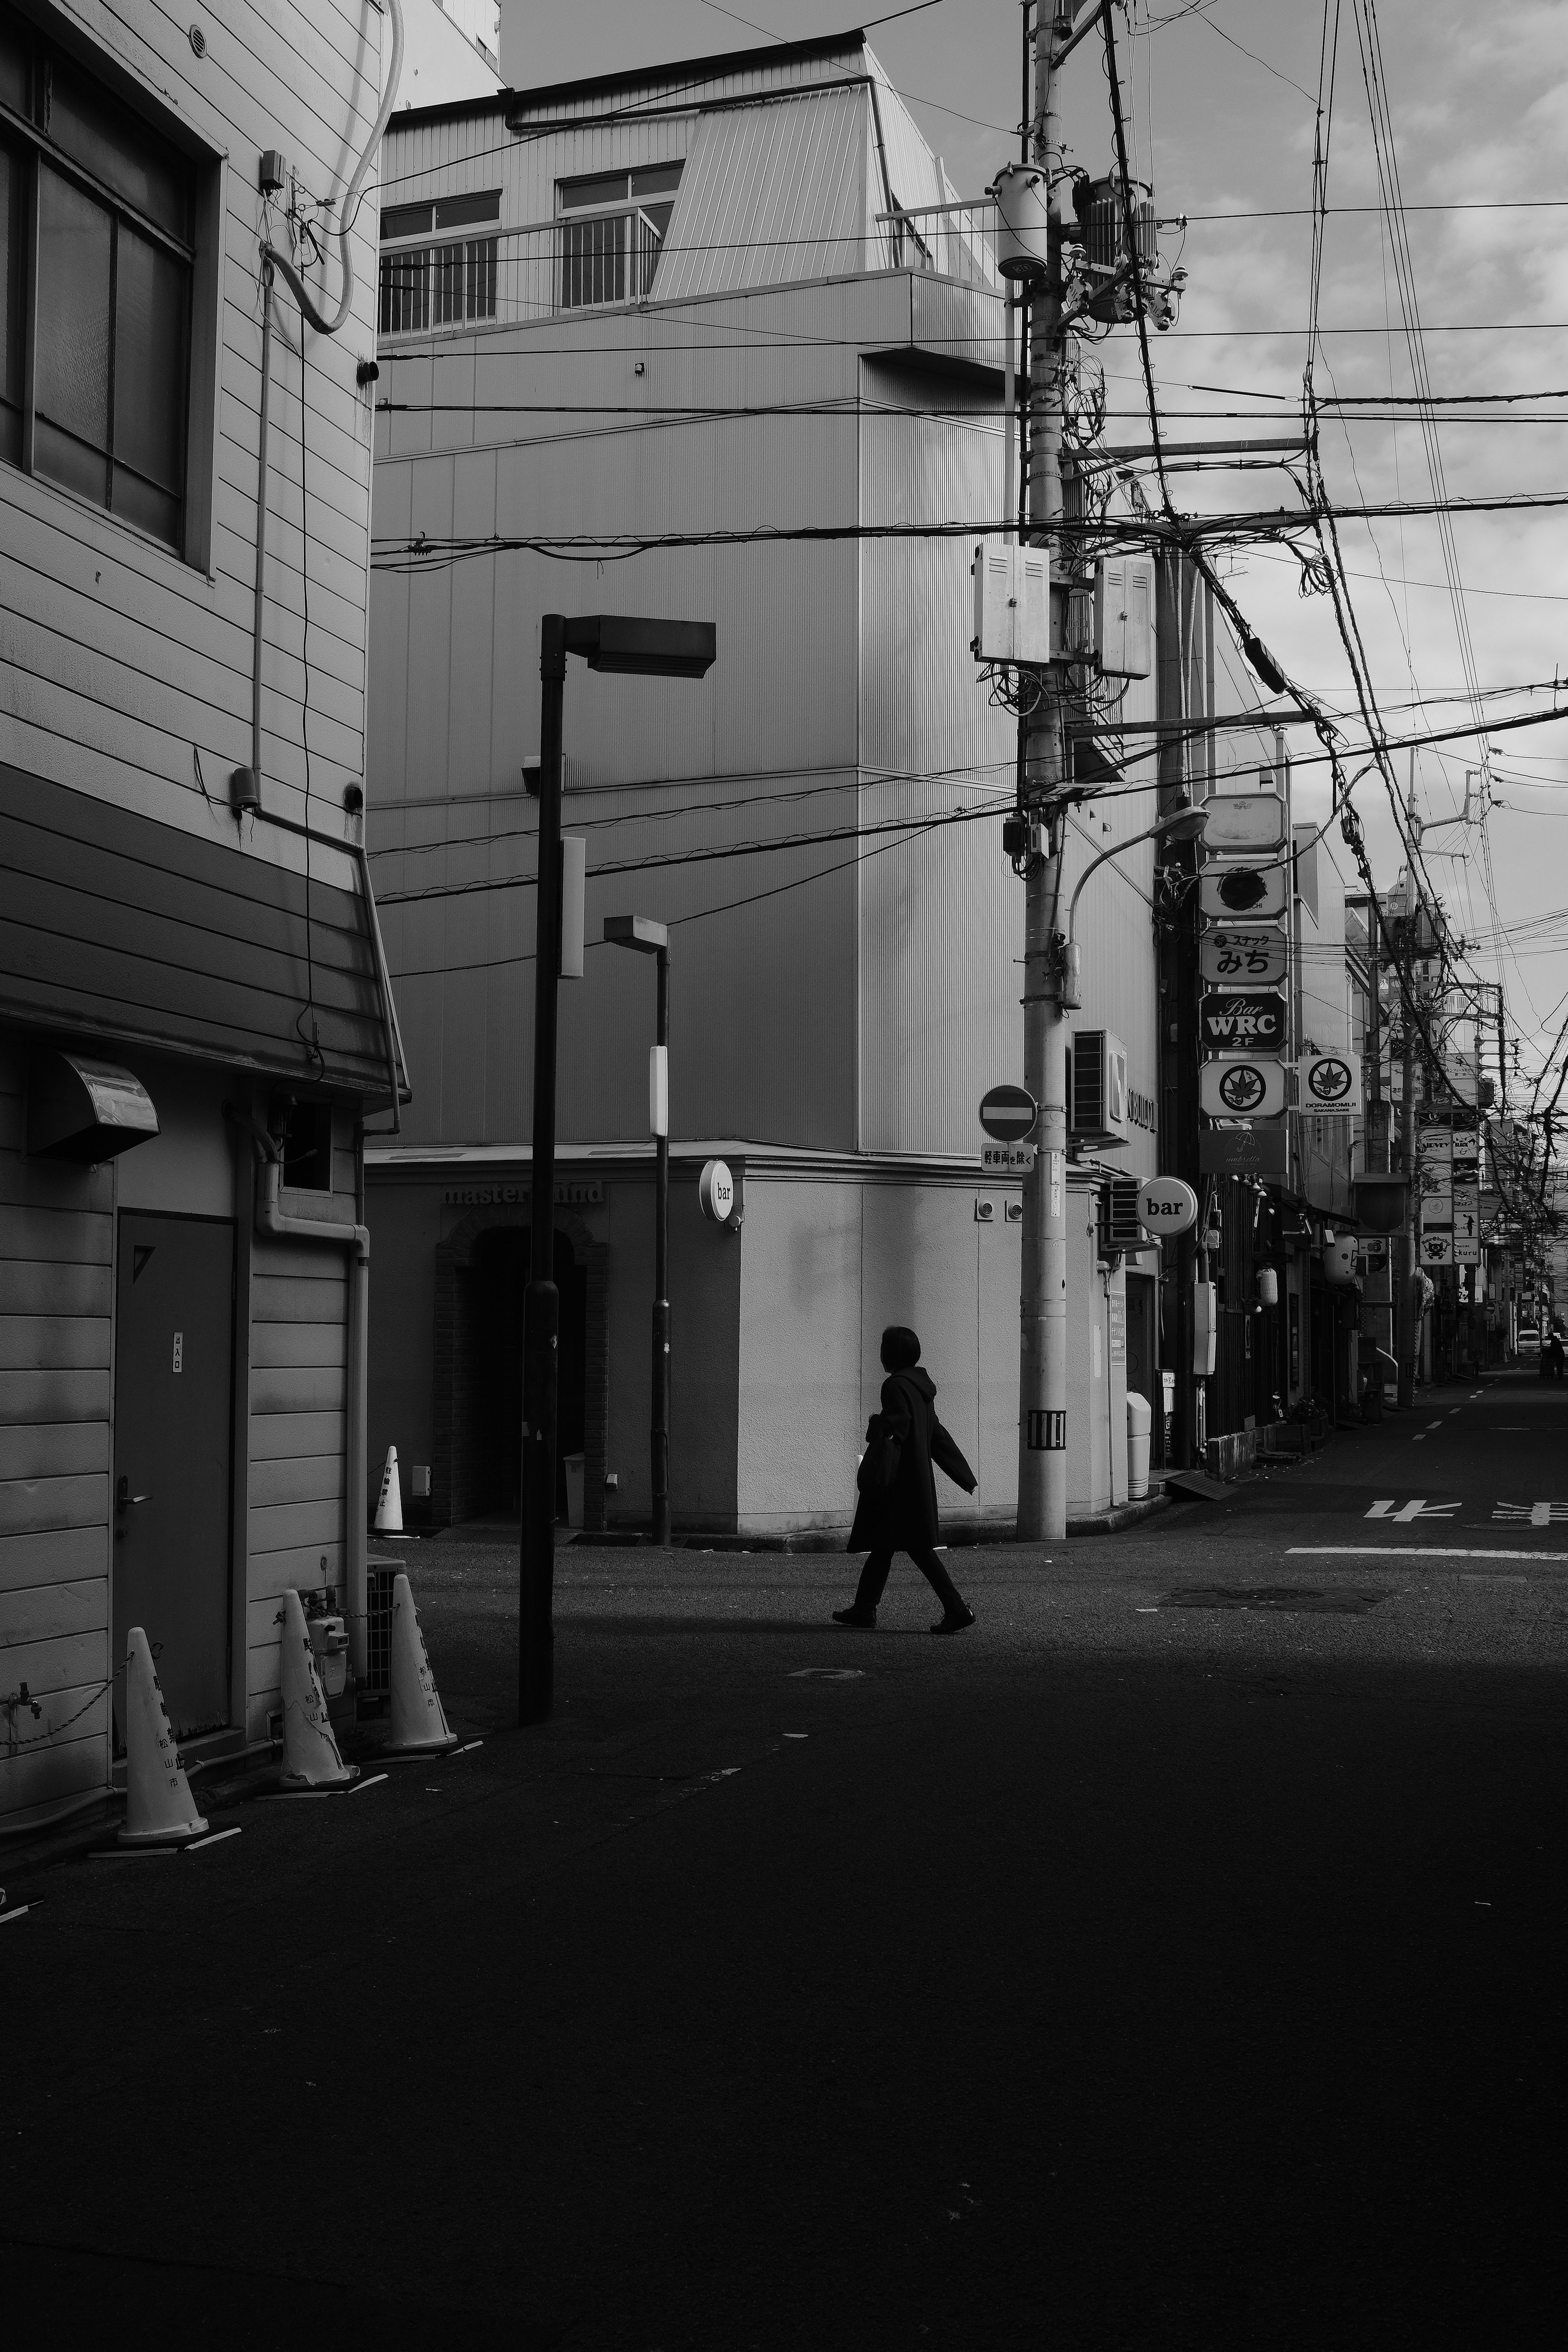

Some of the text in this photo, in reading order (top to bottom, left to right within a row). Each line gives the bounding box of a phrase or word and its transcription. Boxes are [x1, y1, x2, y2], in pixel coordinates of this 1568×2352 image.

[1233, 935, 1269, 946] スナック
[1217, 950, 1269, 974] みち
[1219, 997, 1264, 1016] Bar
[1207, 1014, 1277, 1036] WRC
[1232, 1037, 1254, 1047] 2F
[985, 1151, 1031, 1164] 軽車両を除く
[717, 1182, 731, 1200] bar
[1146, 1198, 1183, 1215] bar
[159, 1738, 178, 1788] 松山市
